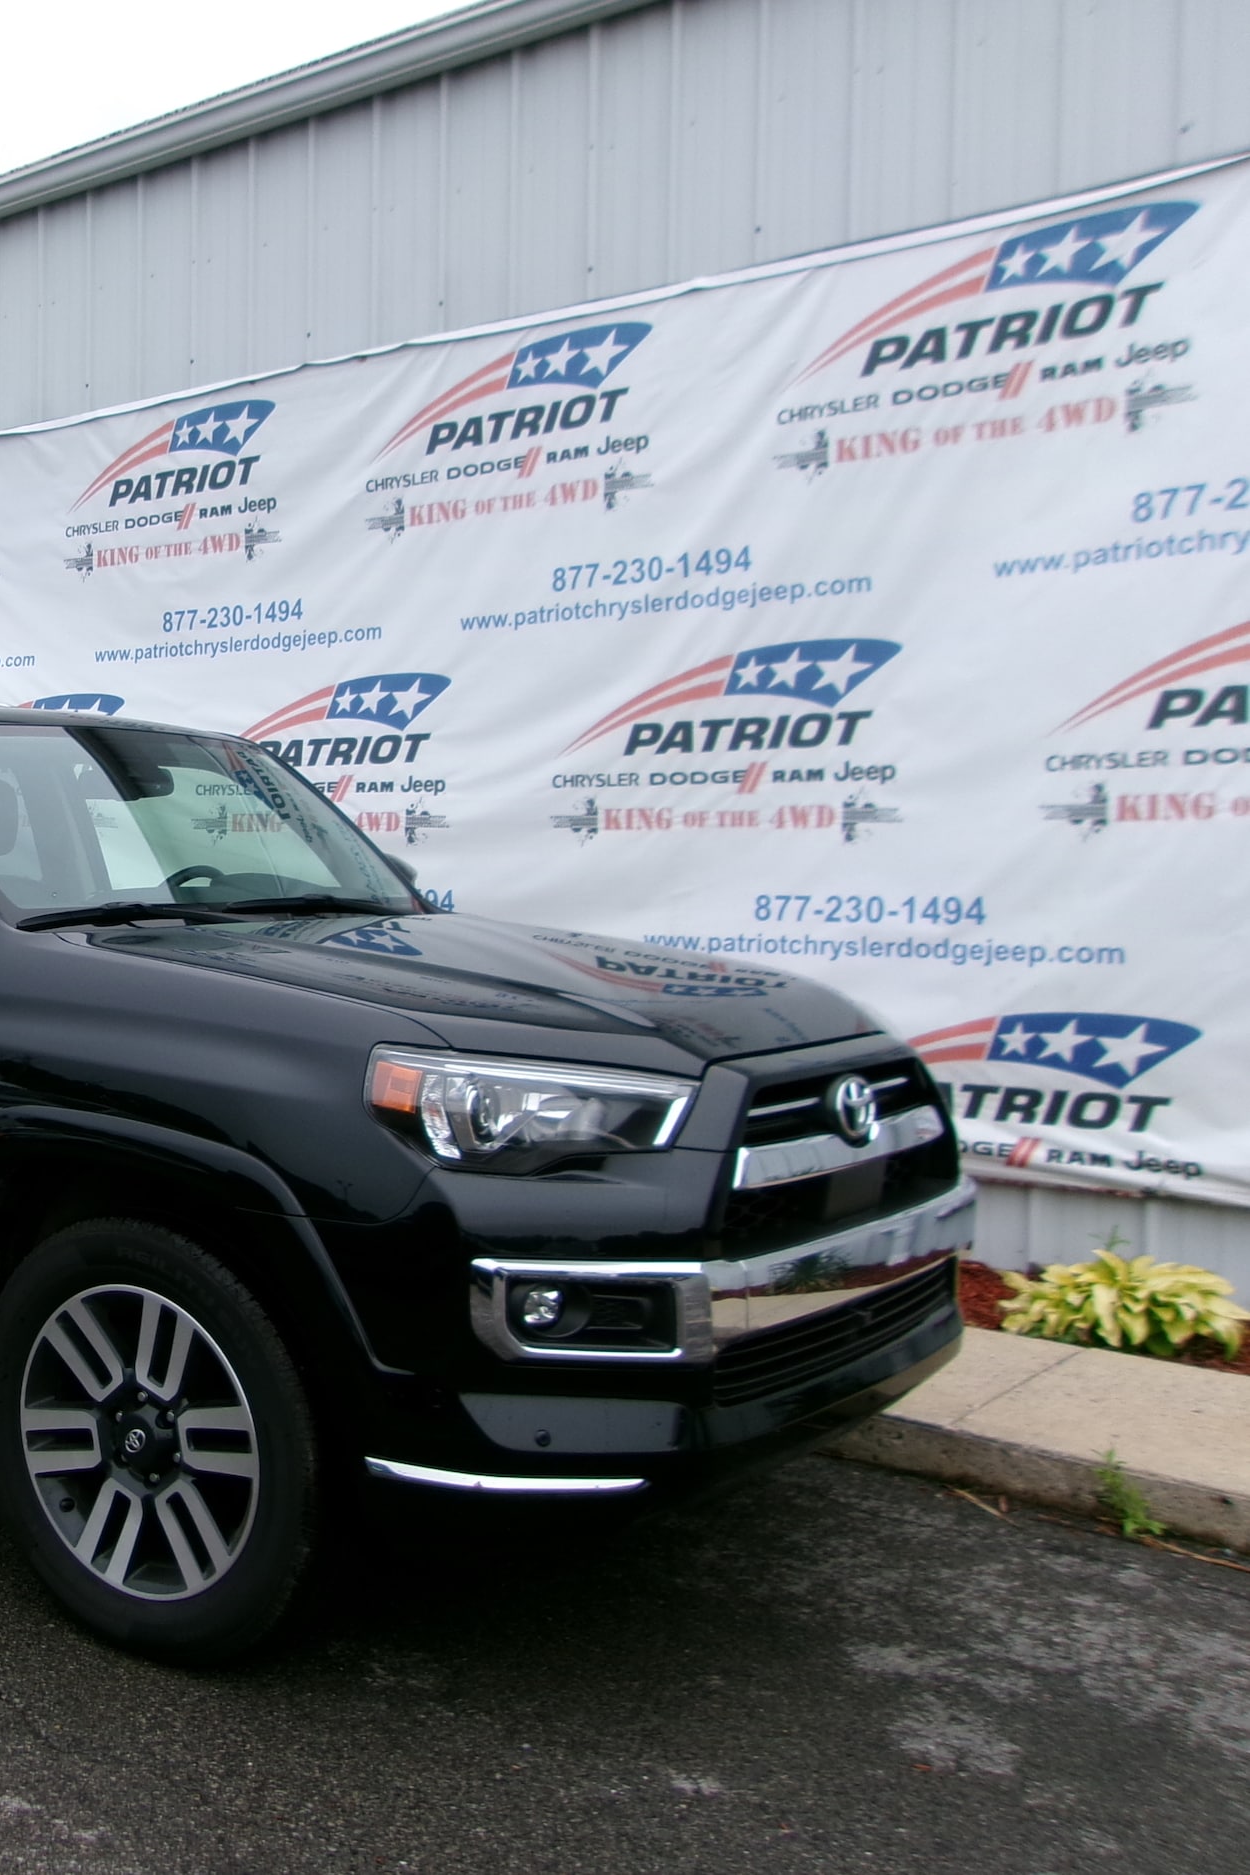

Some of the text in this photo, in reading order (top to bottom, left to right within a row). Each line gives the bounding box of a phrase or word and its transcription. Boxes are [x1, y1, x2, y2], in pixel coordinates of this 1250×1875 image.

[860, 281, 1165, 377] PATRIOT
[776, 338, 1190, 425] CHRYSLER DODGE RAM Jeep
[425, 386, 630, 456] PATRIOT
[834, 396, 1118, 464] KING OF THE 4WD
[108, 455, 261, 507] PATRIOT
[365, 433, 650, 494] CHRYSLER DODGE RAM Jeep
[65, 496, 277, 538] CHRYSLER DODGE RAM Jeep
[409, 478, 599, 527] KING OF THE 4WD
[96, 533, 241, 568] KING OF THE 4WD
[552, 545, 752, 593] 877-230-1494
[162, 598, 304, 633] 877-230-1494
[460, 573, 873, 633] www.patriotchryslerdodgejeep.com
[95, 624, 383, 664] www.patriotchryslerdodgejeep.com
[624, 709, 873, 757] PATRIOT
[552, 761, 896, 789] CHRYSLER DODGE RAM Jeep
[1046, 750, 1169, 772] CHRYSLER
[355, 781, 394, 793] RAM
[401, 775, 446, 796] Jeep
[231, 812, 282, 833] KING
[604, 804, 836, 831] KING OF THE 4WD
[1115, 792, 1216, 822] KING
[754, 895, 986, 925] 877-230-1494
[643, 933, 1125, 967] www.patriotchryslerdodgejeep.com
[938, 1083, 1171, 1133] TRIOT
[1046, 1149, 1203, 1178] RAM Jeep
